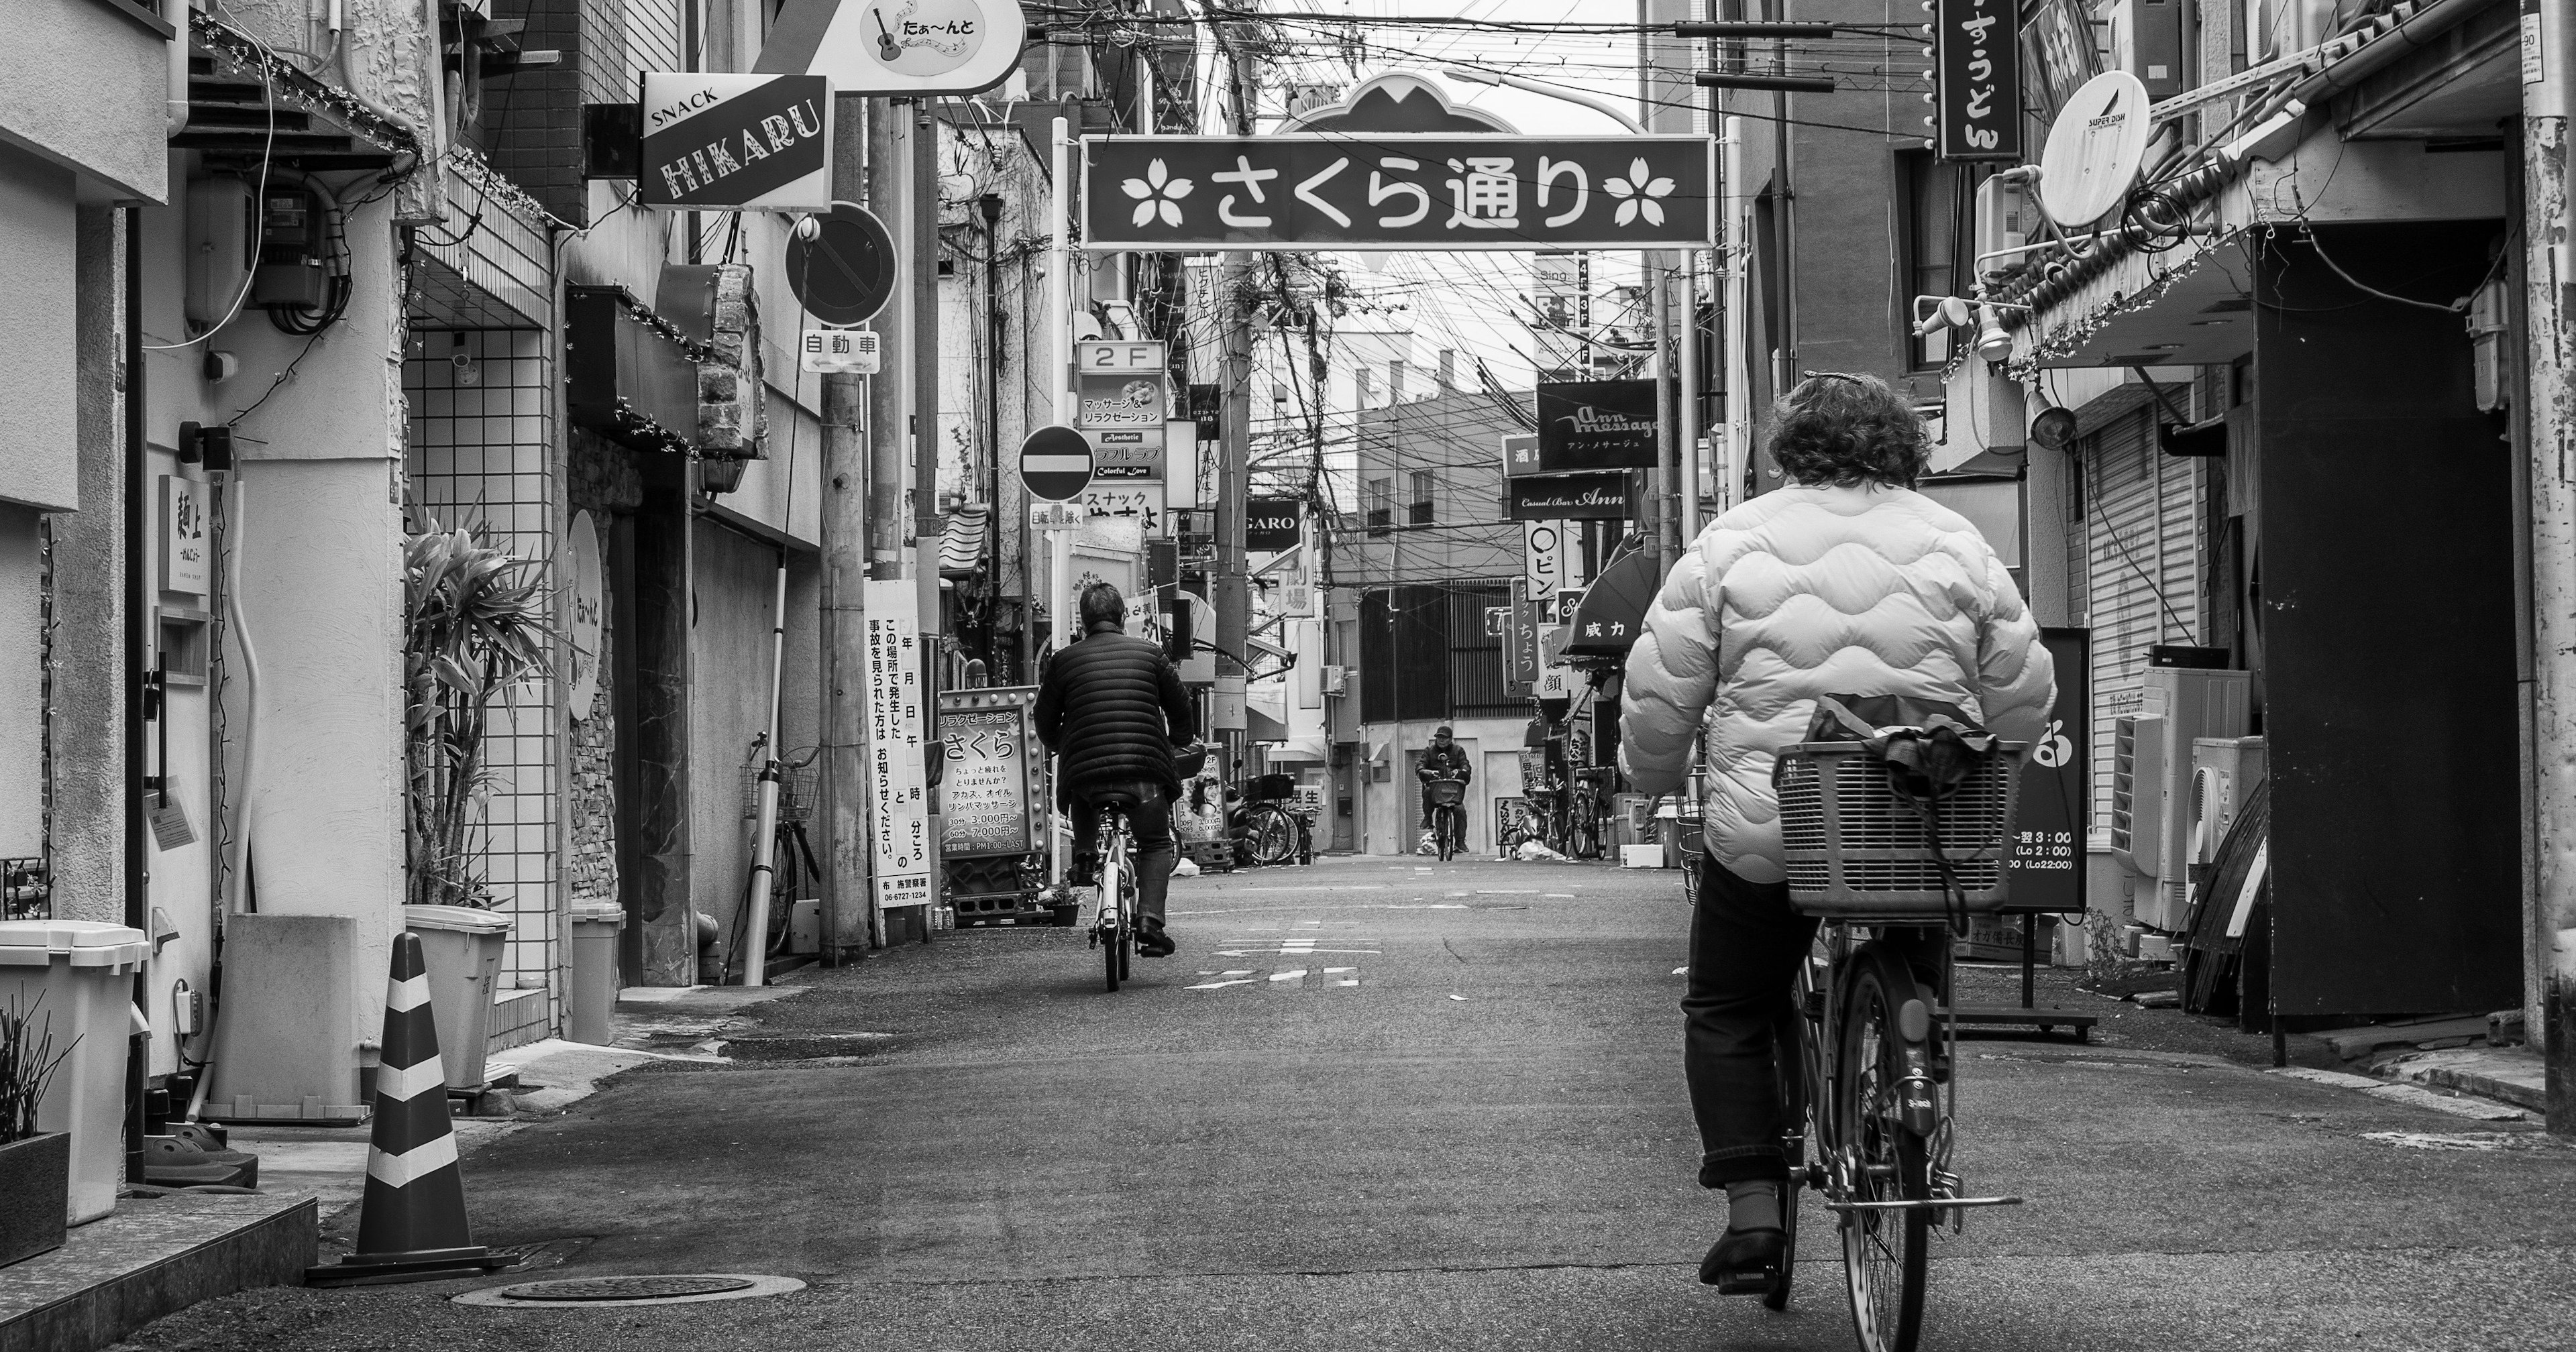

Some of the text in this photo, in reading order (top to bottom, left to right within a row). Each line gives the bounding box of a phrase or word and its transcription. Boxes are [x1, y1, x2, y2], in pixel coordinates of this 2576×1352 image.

[1962, 0, 1998, 149] すうどん
[651, 87, 718, 127] SNACK
[2088, 116, 2109, 126] SUPER
[659, 99, 820, 199] HIKARU
[1212, 155, 1589, 229] さくら通り
[807, 334, 875, 355] 自動車
[1084, 400, 1142, 409] マッサージ &
[1085, 412, 1159, 422] リラクゼーション
[1104, 433, 1139, 442] Aesthetic
[1097, 467, 1147, 476] Colorful Love
[1087, 492, 1146, 506] スナック
[1521, 488, 1624, 507] Casual Bar Ann
[1585, 621, 1625, 638] 威力
[902, 637, 912, 649] 年
[1519, 623, 1534, 671] ちょう
[885, 619, 900, 739] この場所で発生した
[904, 672, 914, 685] 月
[1544, 674, 1562, 692] 顔
[906, 706, 915, 718] 日
[940, 712, 1016, 727] リラクゼーション
[869, 619, 892, 860] 事故を見られた方は お知らせください。
[944, 730, 1014, 760] さくら
[955, 765, 1007, 775] ちょっと疲れを
[910, 787, 920, 800] 時
[949, 818, 966, 826] 30分
[911, 821, 922, 860] 分ころ
[949, 830, 966, 838] 60分
[884, 891, 926, 901] 06-6727-1234
